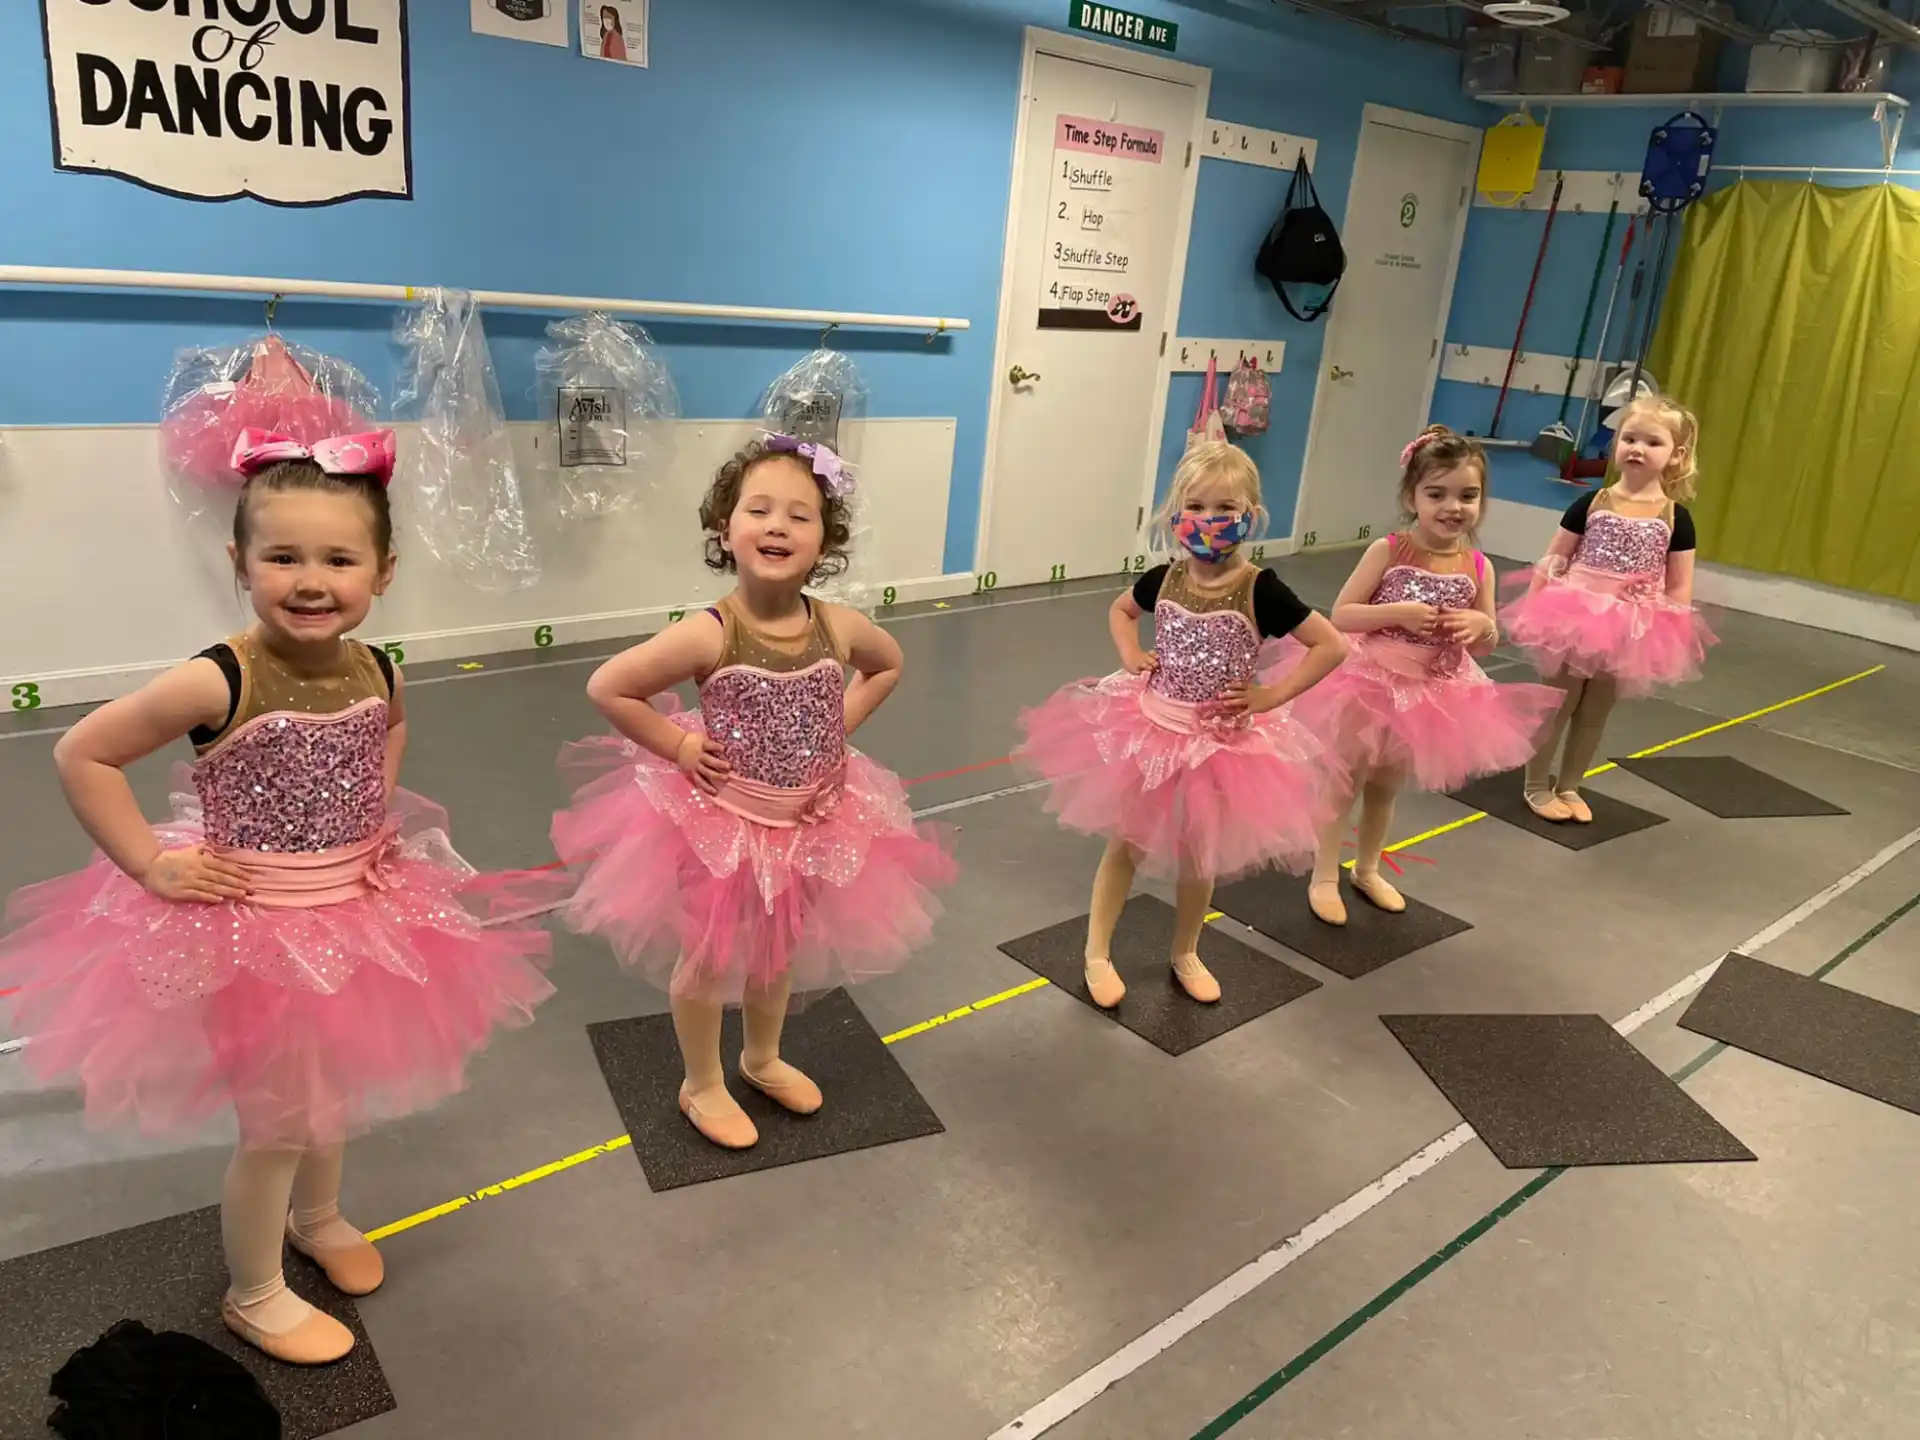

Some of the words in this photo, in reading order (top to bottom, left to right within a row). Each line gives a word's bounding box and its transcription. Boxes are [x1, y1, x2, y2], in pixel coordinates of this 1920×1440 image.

[1081, 4, 1144, 40] DANCER
[1149, 25, 1168, 42] AVE
[76, 52, 393, 156] DANCING
[1064, 123, 1090, 144] Time
[1093, 129, 1117, 153] Step
[1120, 132, 1157, 154] Formula
[1071, 168, 1113, 186] Shuffle
[1083, 209, 1103, 228] Hop
[1062, 248, 1102, 265] Shuffle
[1104, 252, 1129, 270] Step
[1062, 286, 1083, 305] Flap
[1085, 288, 1110, 305] Step
[1302, 531, 1317, 546] 15
[1357, 525, 1371, 540] 16
[1250, 545, 1264, 560] 14
[975, 571, 997, 593] 10
[1050, 564, 1066, 580] 11
[883, 586, 896, 605] 9
[534, 625, 553, 647] 6
[384, 641, 404, 664] 5
[11, 682, 41, 710] 3
